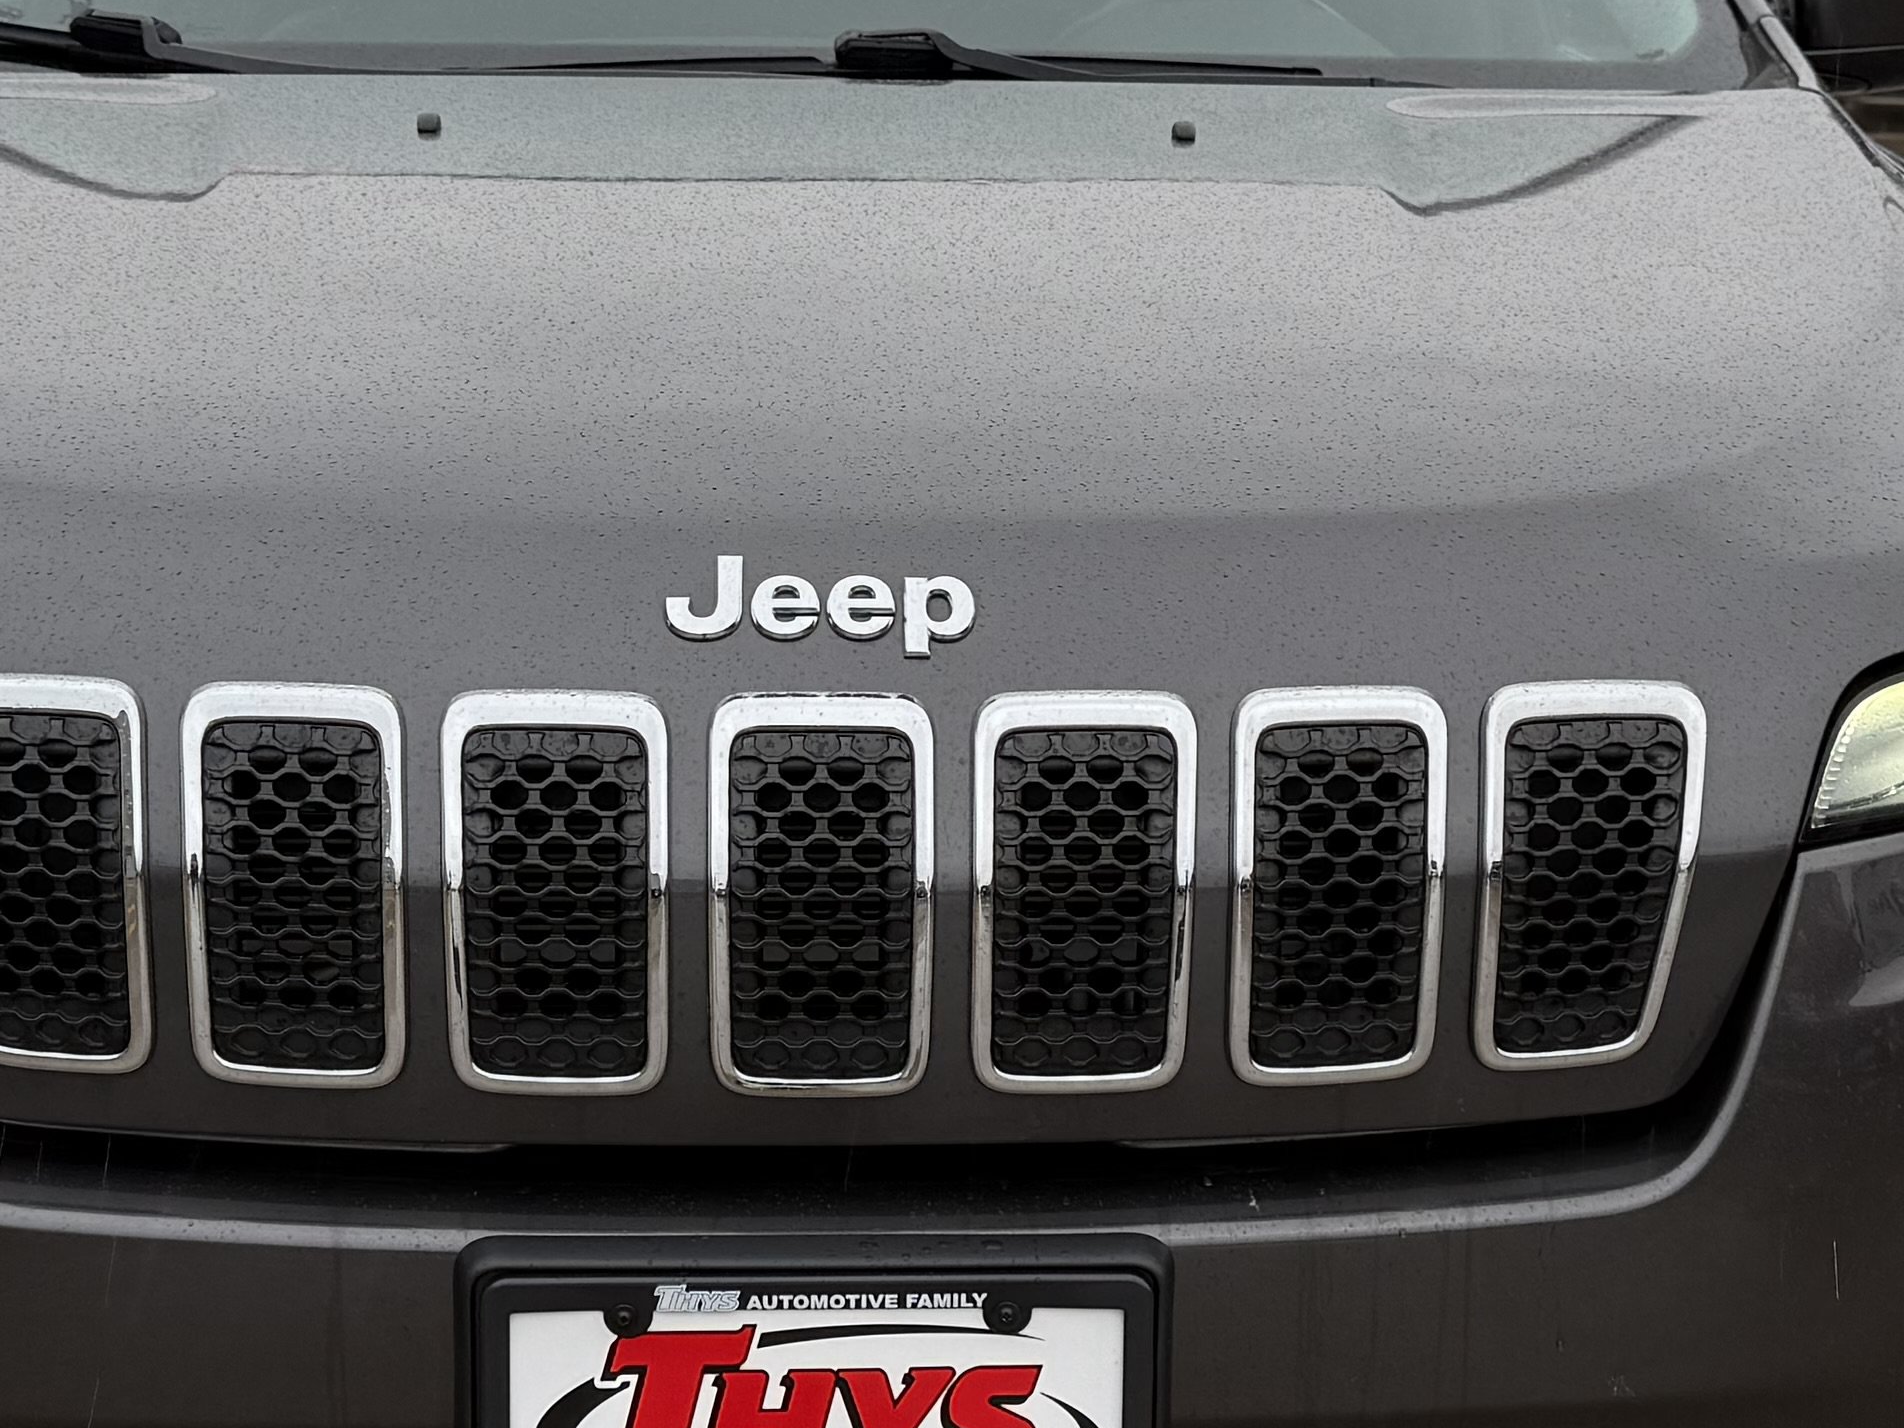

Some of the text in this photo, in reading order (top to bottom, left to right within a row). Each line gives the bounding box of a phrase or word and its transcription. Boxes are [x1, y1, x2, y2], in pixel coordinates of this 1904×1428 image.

[665, 554, 976, 660] Jeep
[654, 1284, 988, 1312] THYS AUTOMOTIVE FAMILY
